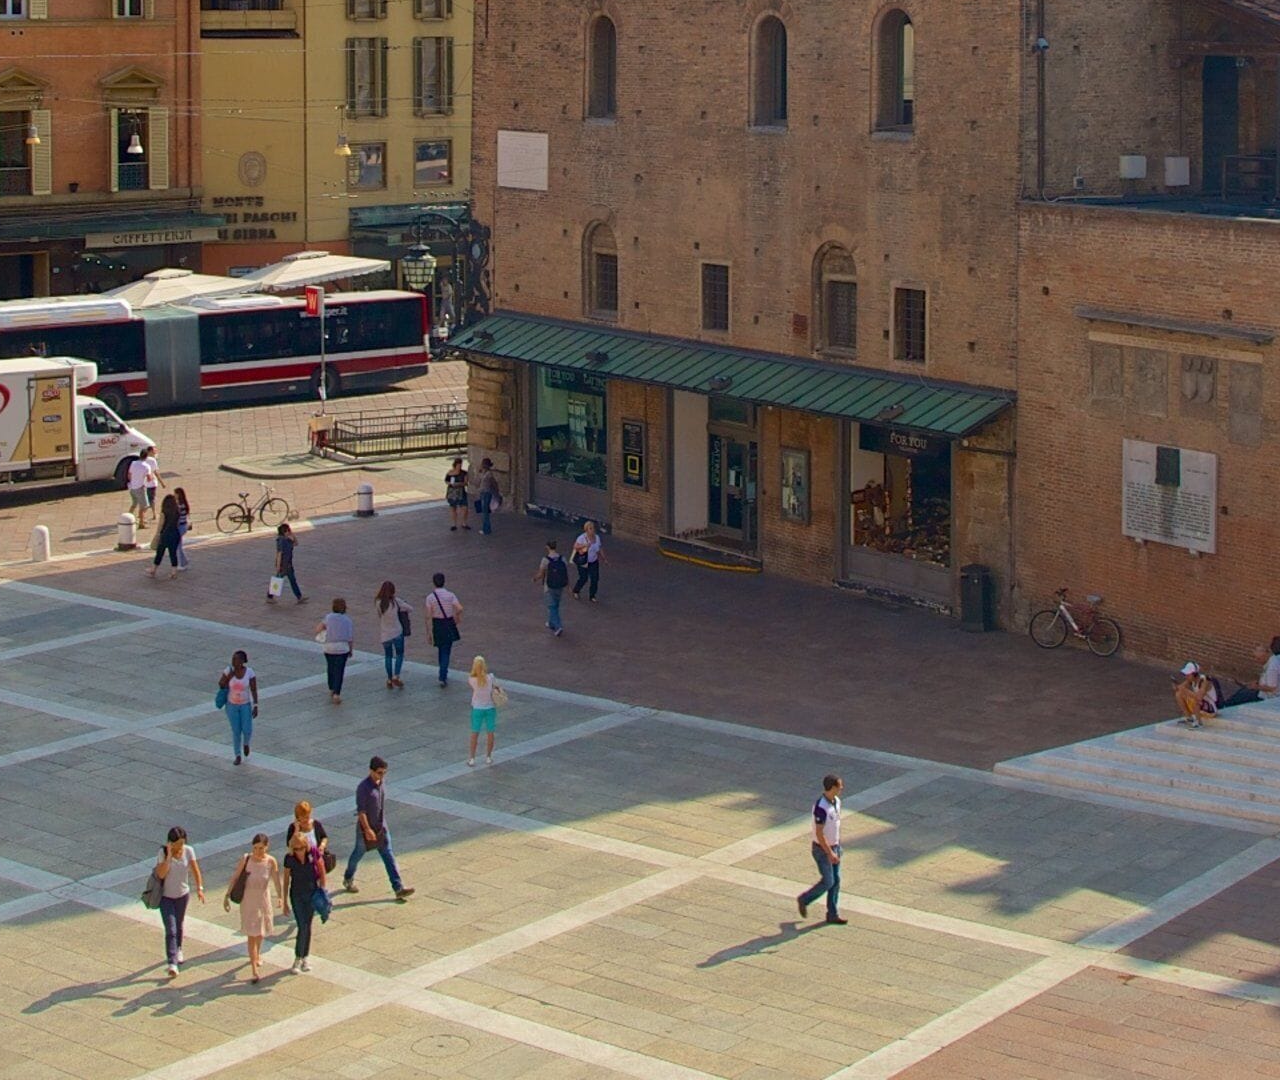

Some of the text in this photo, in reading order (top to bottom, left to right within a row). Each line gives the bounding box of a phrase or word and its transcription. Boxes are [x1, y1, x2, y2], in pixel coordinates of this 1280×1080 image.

[212, 196, 264, 207] MONTE
[243, 212, 298, 223] PASCHI
[890, 432, 928, 449] FOR YOU
